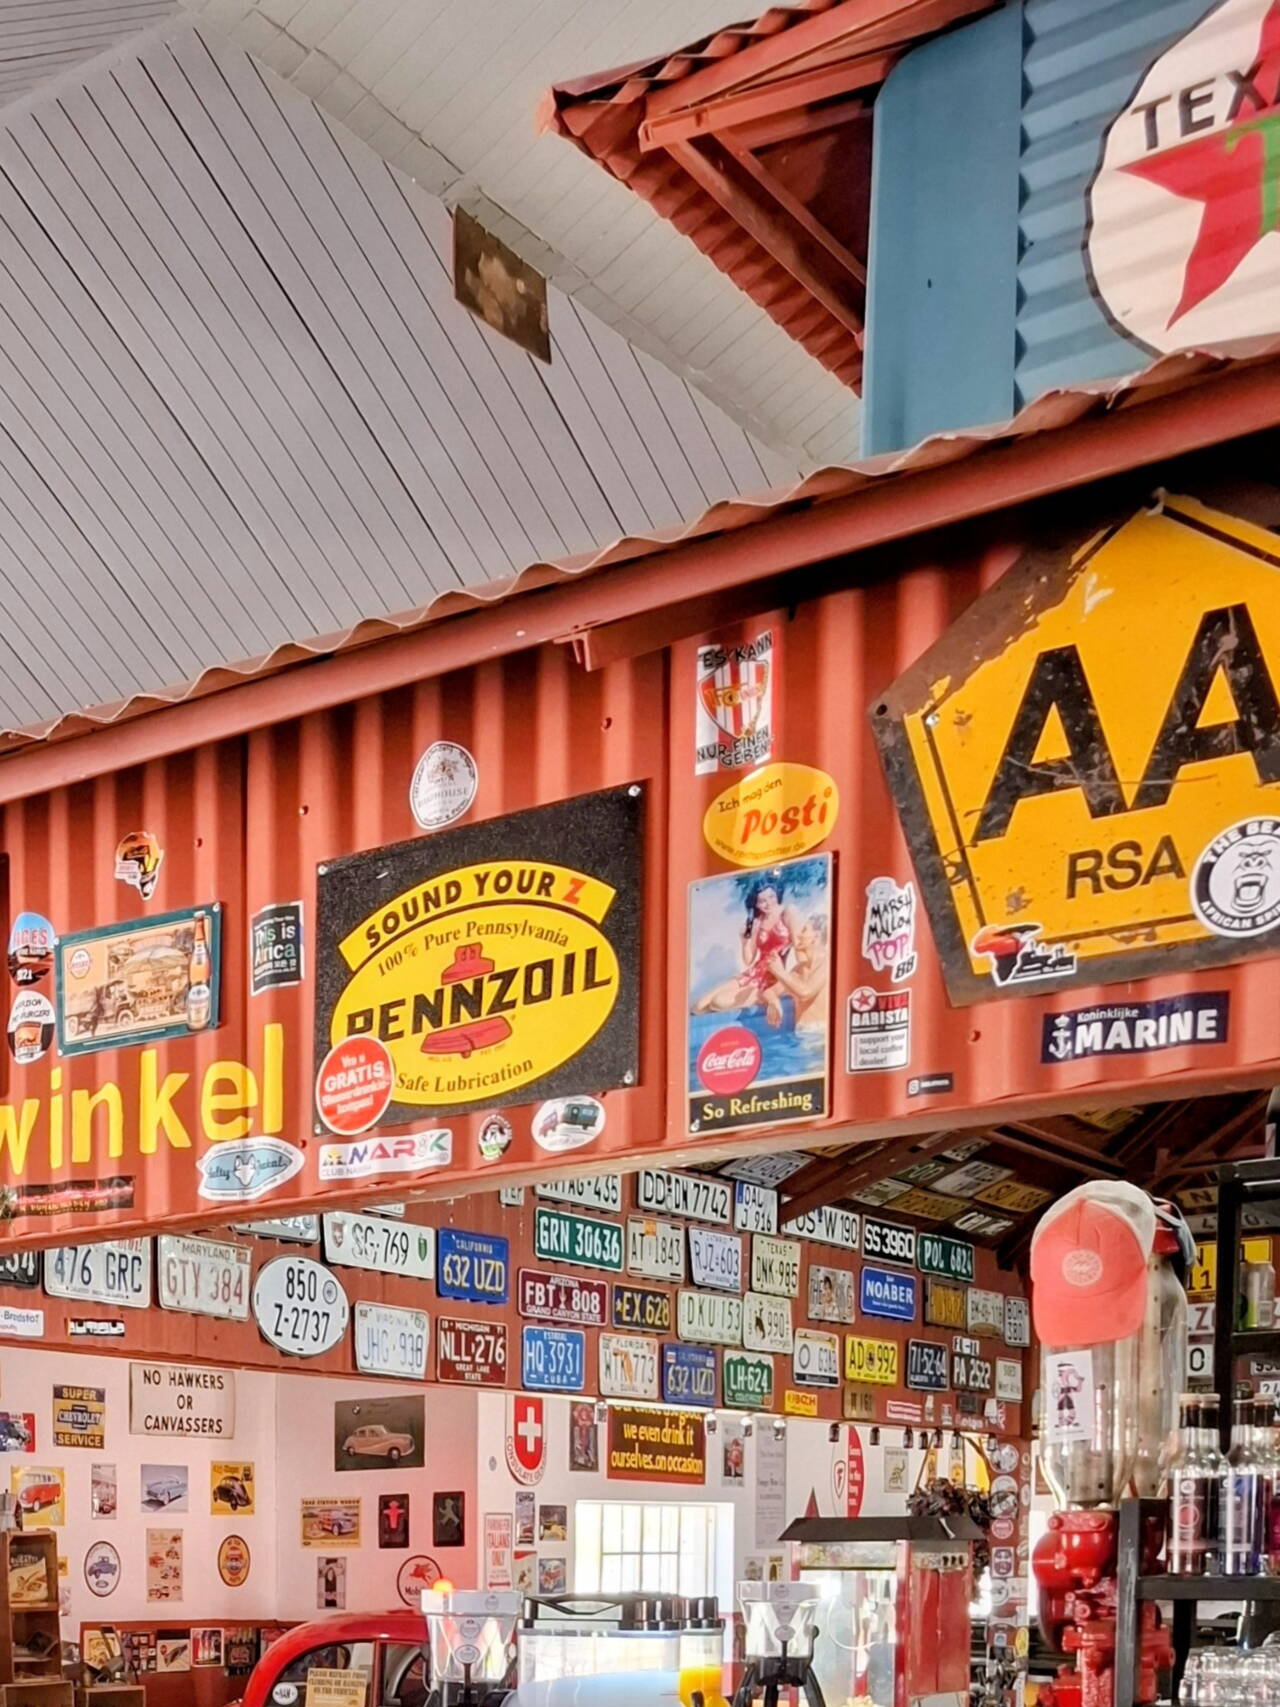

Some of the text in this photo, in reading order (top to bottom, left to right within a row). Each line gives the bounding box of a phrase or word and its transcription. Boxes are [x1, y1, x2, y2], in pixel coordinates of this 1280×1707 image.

[703, 634, 773, 670] ES KANN
[971, 603, 1280, 842] AA
[697, 743, 727, 762] NUR
[718, 777, 782, 814] Ich mag den
[1203, 826, 1242, 863] THE
[1066, 835, 1186, 899] RSA
[366, 869, 587, 949] SOUND YOUR Z
[1200, 901, 1254, 929] AFRICAN
[254, 923, 296, 944] This is
[424, 919, 570, 953] Pure Pennsylvania
[347, 946, 613, 1045] PENNZOIL
[851, 1009, 908, 1028] BARISTA
[1077, 1007, 1139, 1023] Koninklijke
[1075, 1009, 1218, 1055] MARINE
[324, 1061, 385, 1093] GRATIS
[396, 1060, 534, 1094] Safe Lubrication
[703, 1091, 813, 1121] So Refreshing
[644, 1173, 728, 1219] DD 7742
[539, 1215, 619, 1263] GRN 30636
[840, 1214, 858, 1245] 190
[182, 1241, 232, 1261] MARYLAND
[455, 1239, 493, 1254] CALIFORNIA
[720, 1244, 739, 1277] 603
[767, 1242, 787, 1257] TEXAS
[924, 1239, 945, 1269] POL
[106, 1251, 143, 1293] GRC
[168, 1259, 244, 1306] GTY 384
[285, 1265, 318, 1302] 850
[443, 1254, 506, 1293] 632 UZD
[549, 1275, 580, 1289] ARIZONA
[525, 1280, 601, 1314] FBT 808
[866, 1280, 914, 1305] NOABER
[273, 1303, 331, 1344] Z-2737
[455, 1321, 490, 1334] MICHIGAN
[526, 1304, 601, 1323] GRAND CANYON STATE
[721, 1299, 741, 1330] 153
[455, 1362, 473, 1373] GREAT
[848, 1341, 897, 1375] AD 992
[954, 1355, 991, 1390] PA 2522
[143, 1369, 225, 1391] NO HAWKERS
[464, 1372, 482, 1381] STATE
[544, 1374, 568, 1384] CUBA
[62, 1387, 97, 1401] SUPER
[176, 1394, 193, 1411] OR
[57, 1409, 103, 1425] CHEVROLET
[144, 1415, 223, 1434] CANVASSERS
[623, 1418, 694, 1446] we even drink it
[57, 1433, 102, 1447] SERVICE
[667, 1452, 703, 1475] occasion
